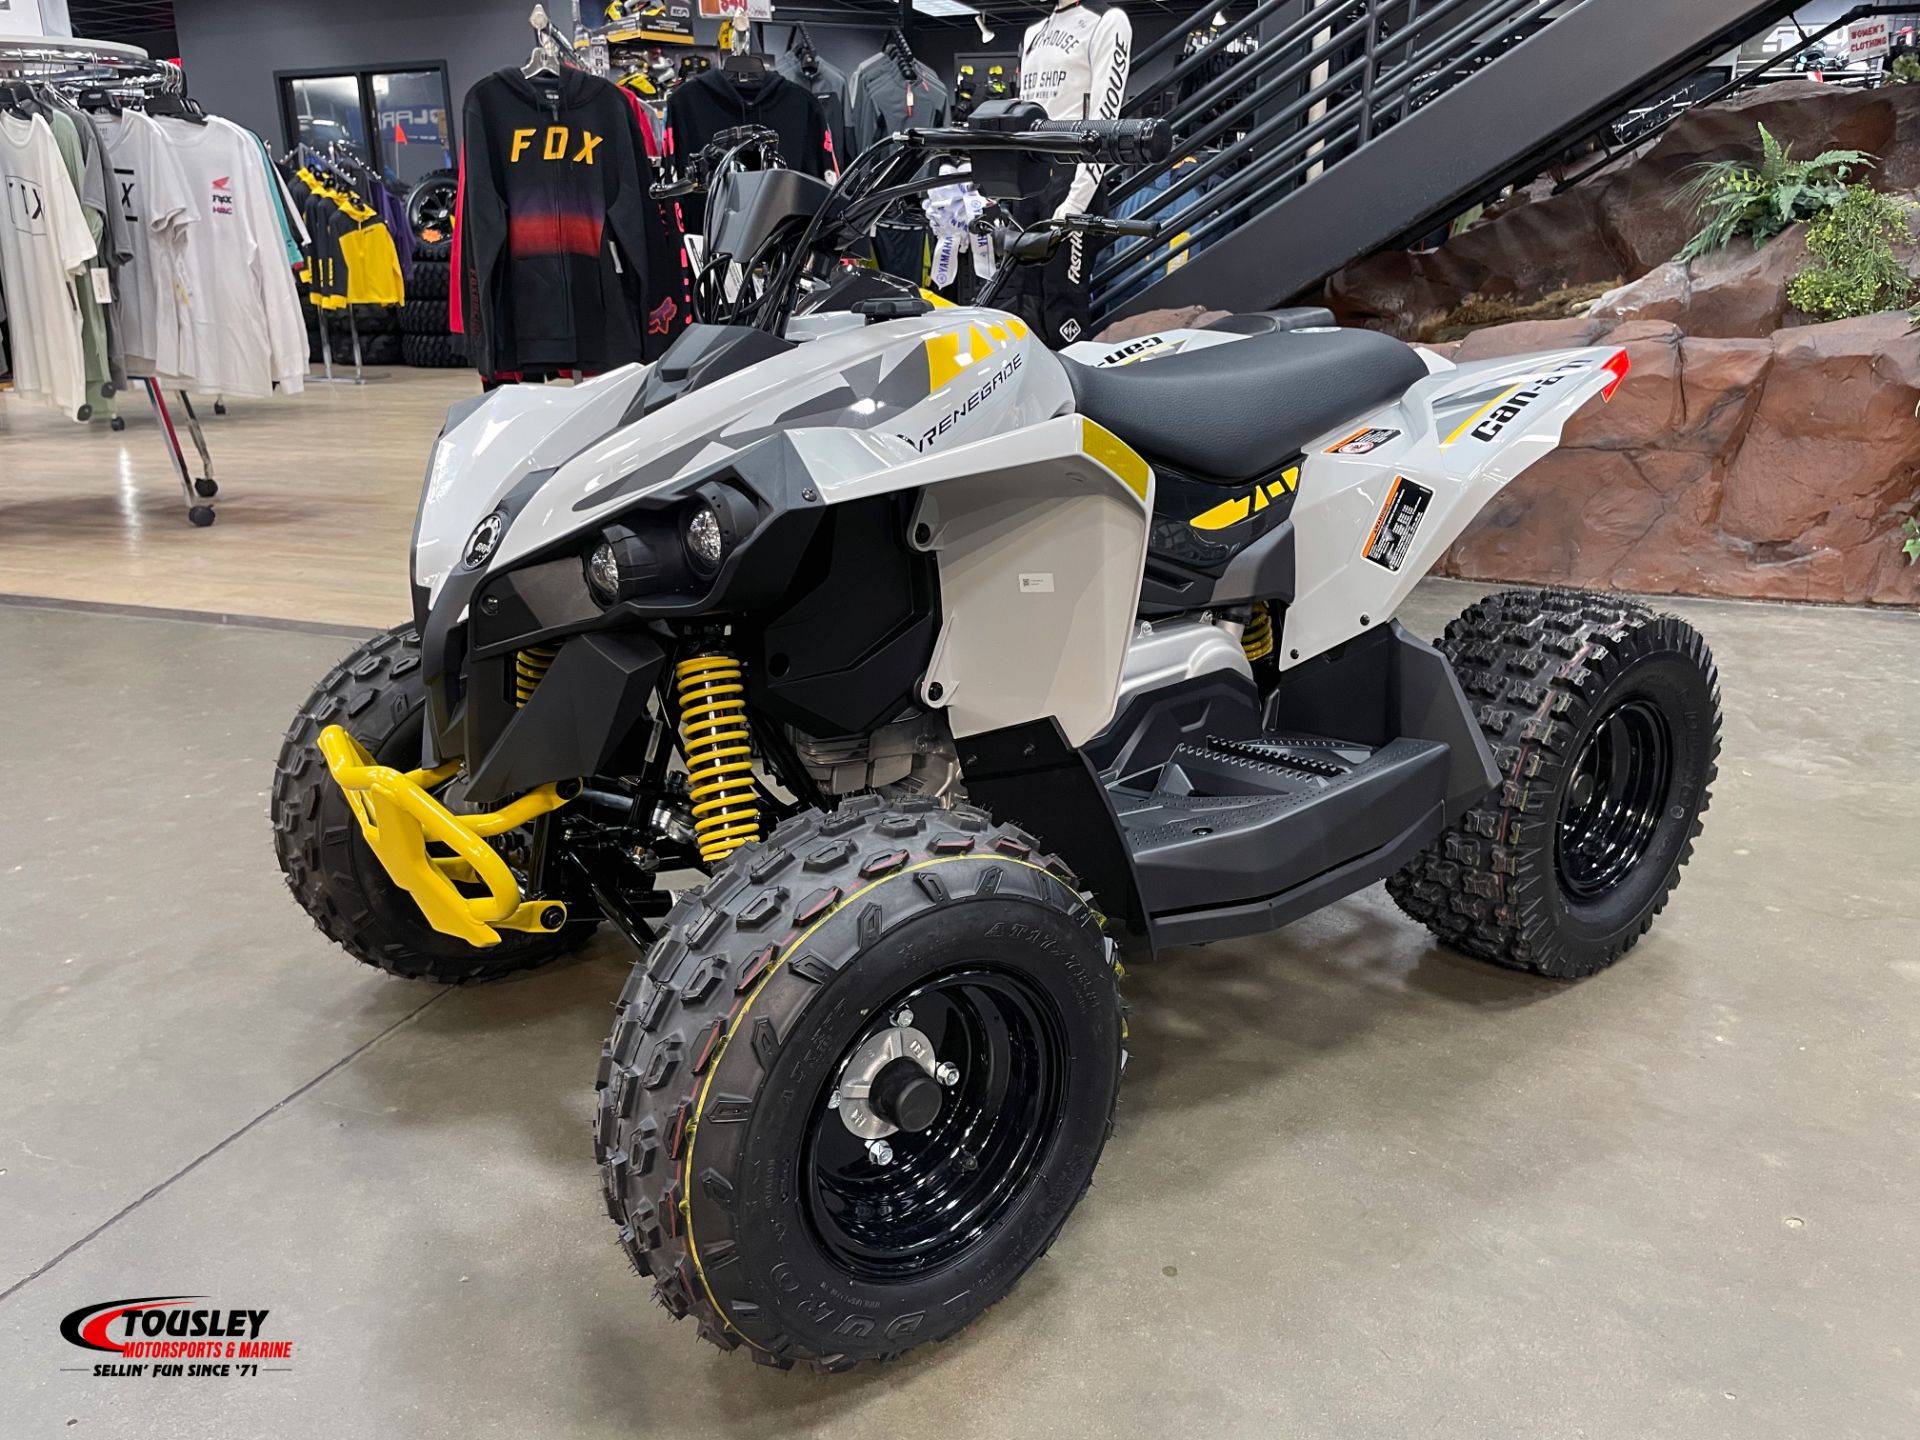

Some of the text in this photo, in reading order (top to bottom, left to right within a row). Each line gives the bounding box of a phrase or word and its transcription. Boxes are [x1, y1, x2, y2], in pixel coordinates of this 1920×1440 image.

[1850, 36, 1887, 53] CLOTHING
[1040, 70, 1067, 88] SHOP
[510, 126, 604, 165] FOX
[938, 236, 953, 273] YAMAHA
[926, 353, 1023, 447] RENEGADE
